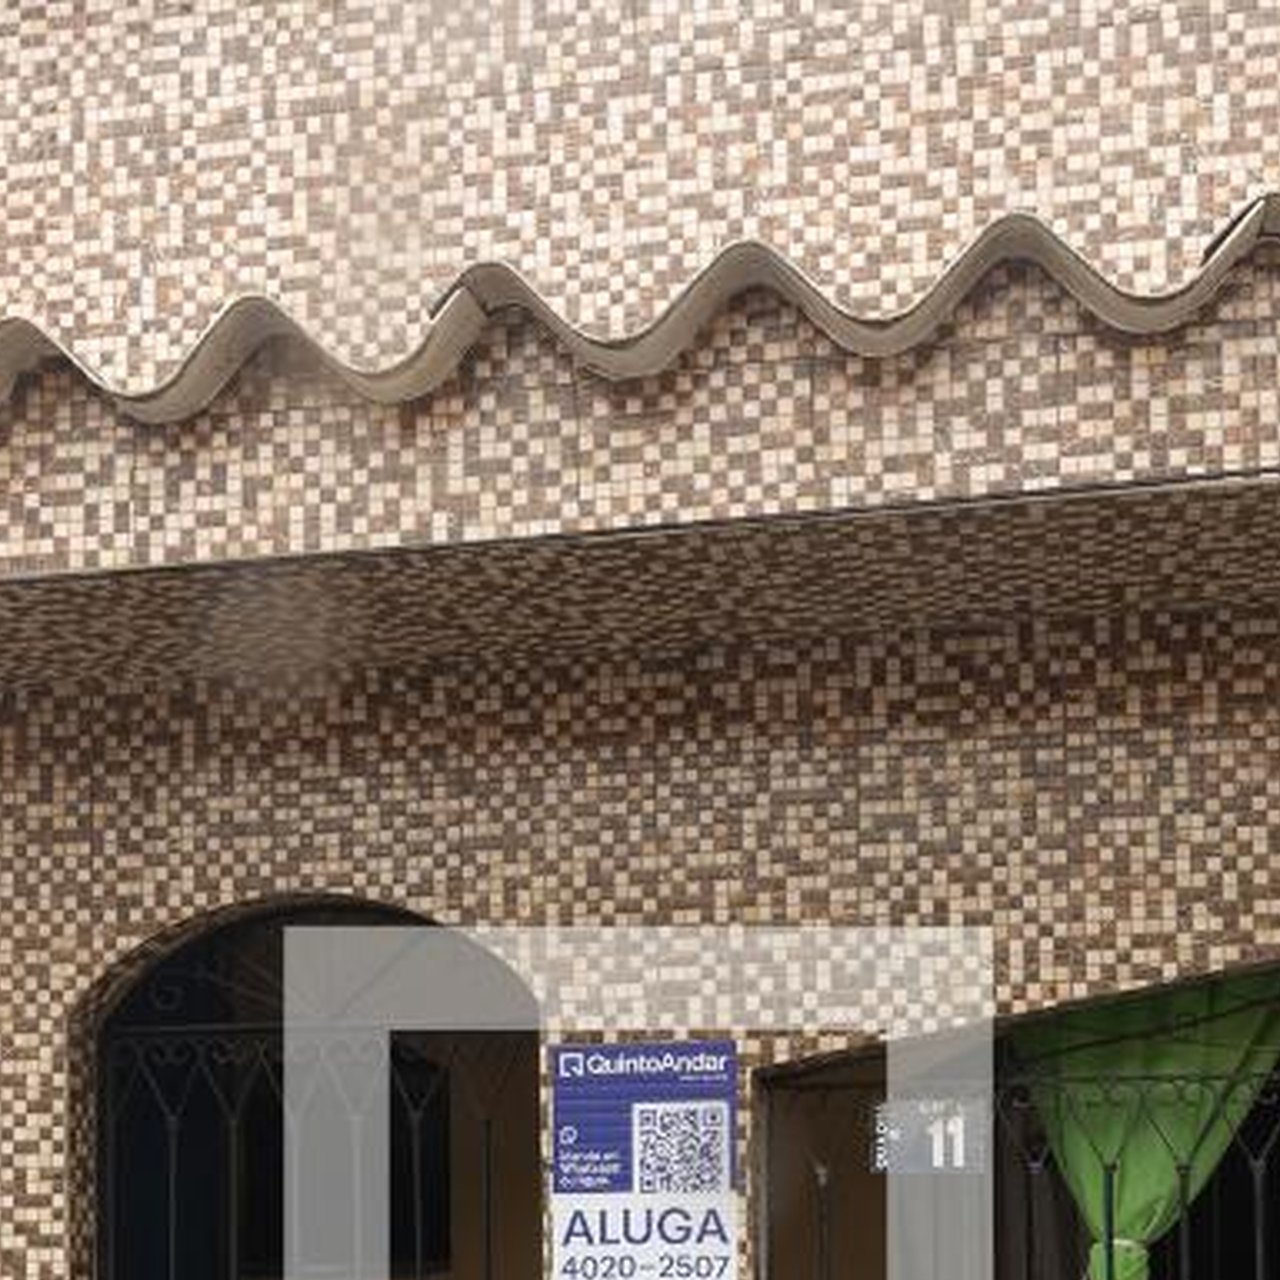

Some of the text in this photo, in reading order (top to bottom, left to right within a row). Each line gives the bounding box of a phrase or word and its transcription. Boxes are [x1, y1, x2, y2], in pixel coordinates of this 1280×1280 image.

[586, 1053, 729, 1076] QuintoAndar
[926, 1116, 965, 1168] 11
[562, 1207, 728, 1246] ALUGA
[561, 1254, 730, 1280] 4020-2507
